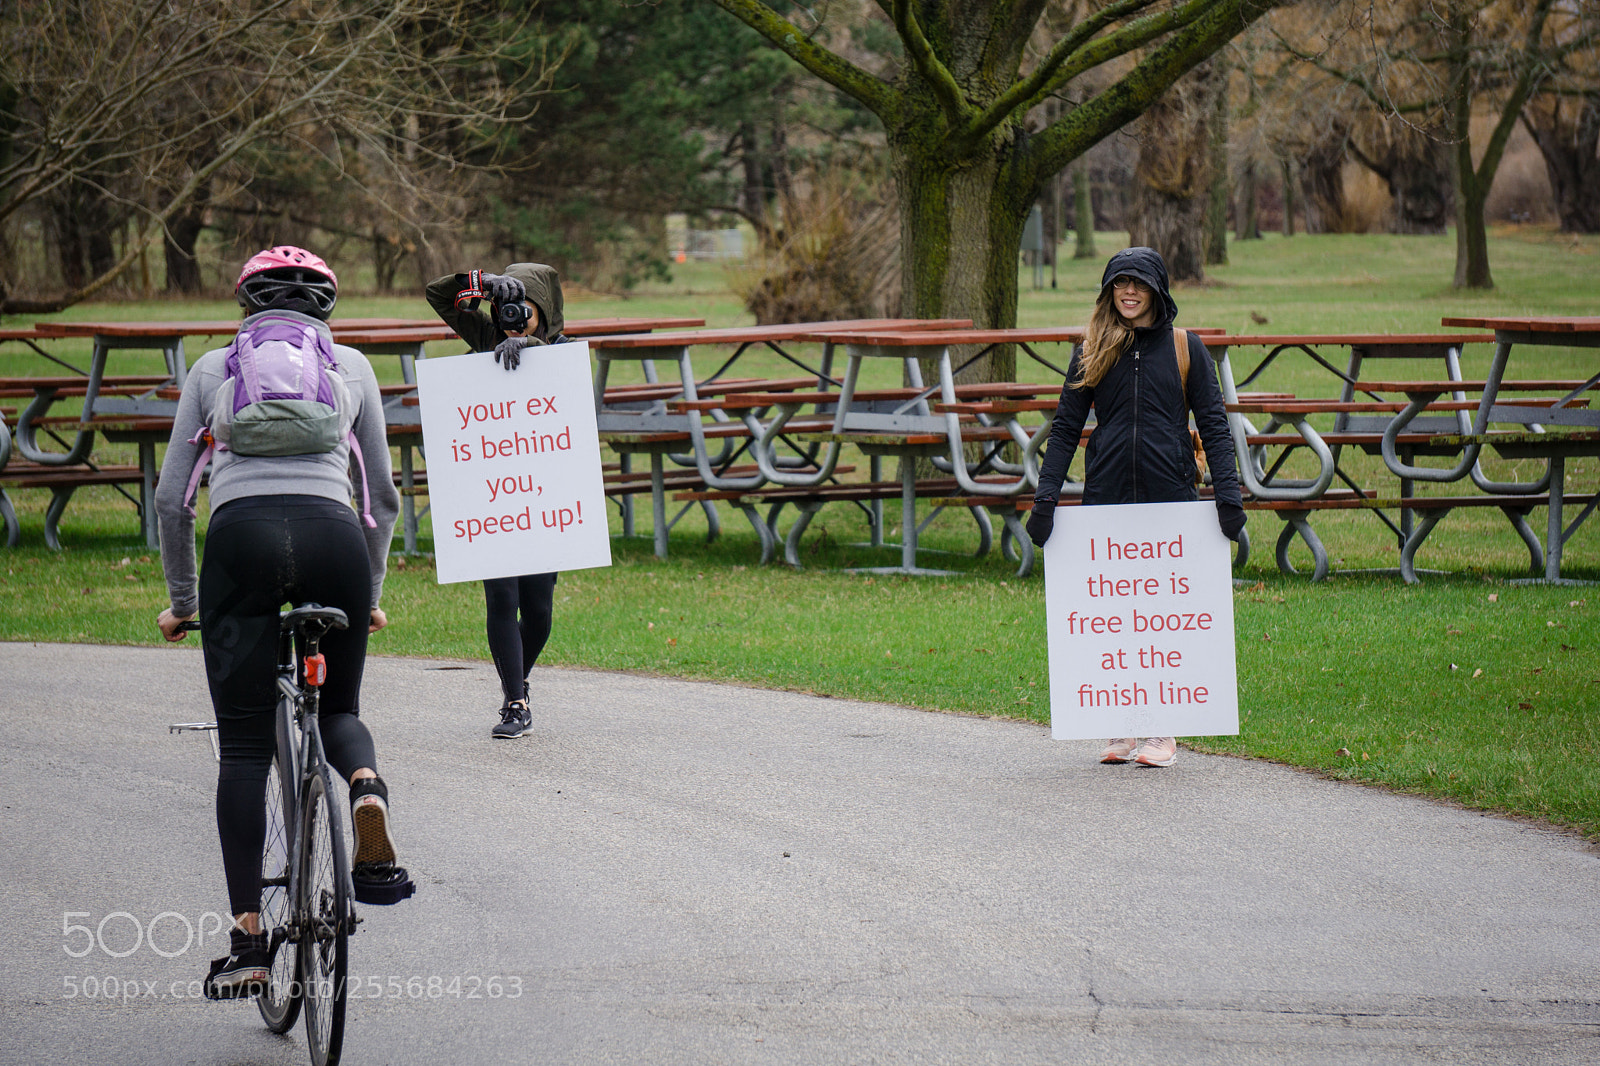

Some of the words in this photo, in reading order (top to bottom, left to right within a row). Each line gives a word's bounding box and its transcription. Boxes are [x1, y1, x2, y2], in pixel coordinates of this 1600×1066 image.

[457, 400, 517, 431] your
[526, 395, 558, 416] ex
[451, 439, 472, 463] is
[481, 425, 572, 460] behind
[486, 474, 543, 503] you,
[454, 506, 532, 543] speed
[541, 500, 583, 533] up!
[1090, 538, 1096, 561] I
[1107, 534, 1183, 561] heard
[1086, 573, 1160, 598] there
[1169, 571, 1190, 595] is
[1067, 611, 1123, 635] free
[1133, 608, 1213, 633] booze
[1101, 648, 1128, 671] at
[1137, 644, 1182, 669] the
[1077, 682, 1148, 708] finish
[1159, 681, 1209, 705] line
